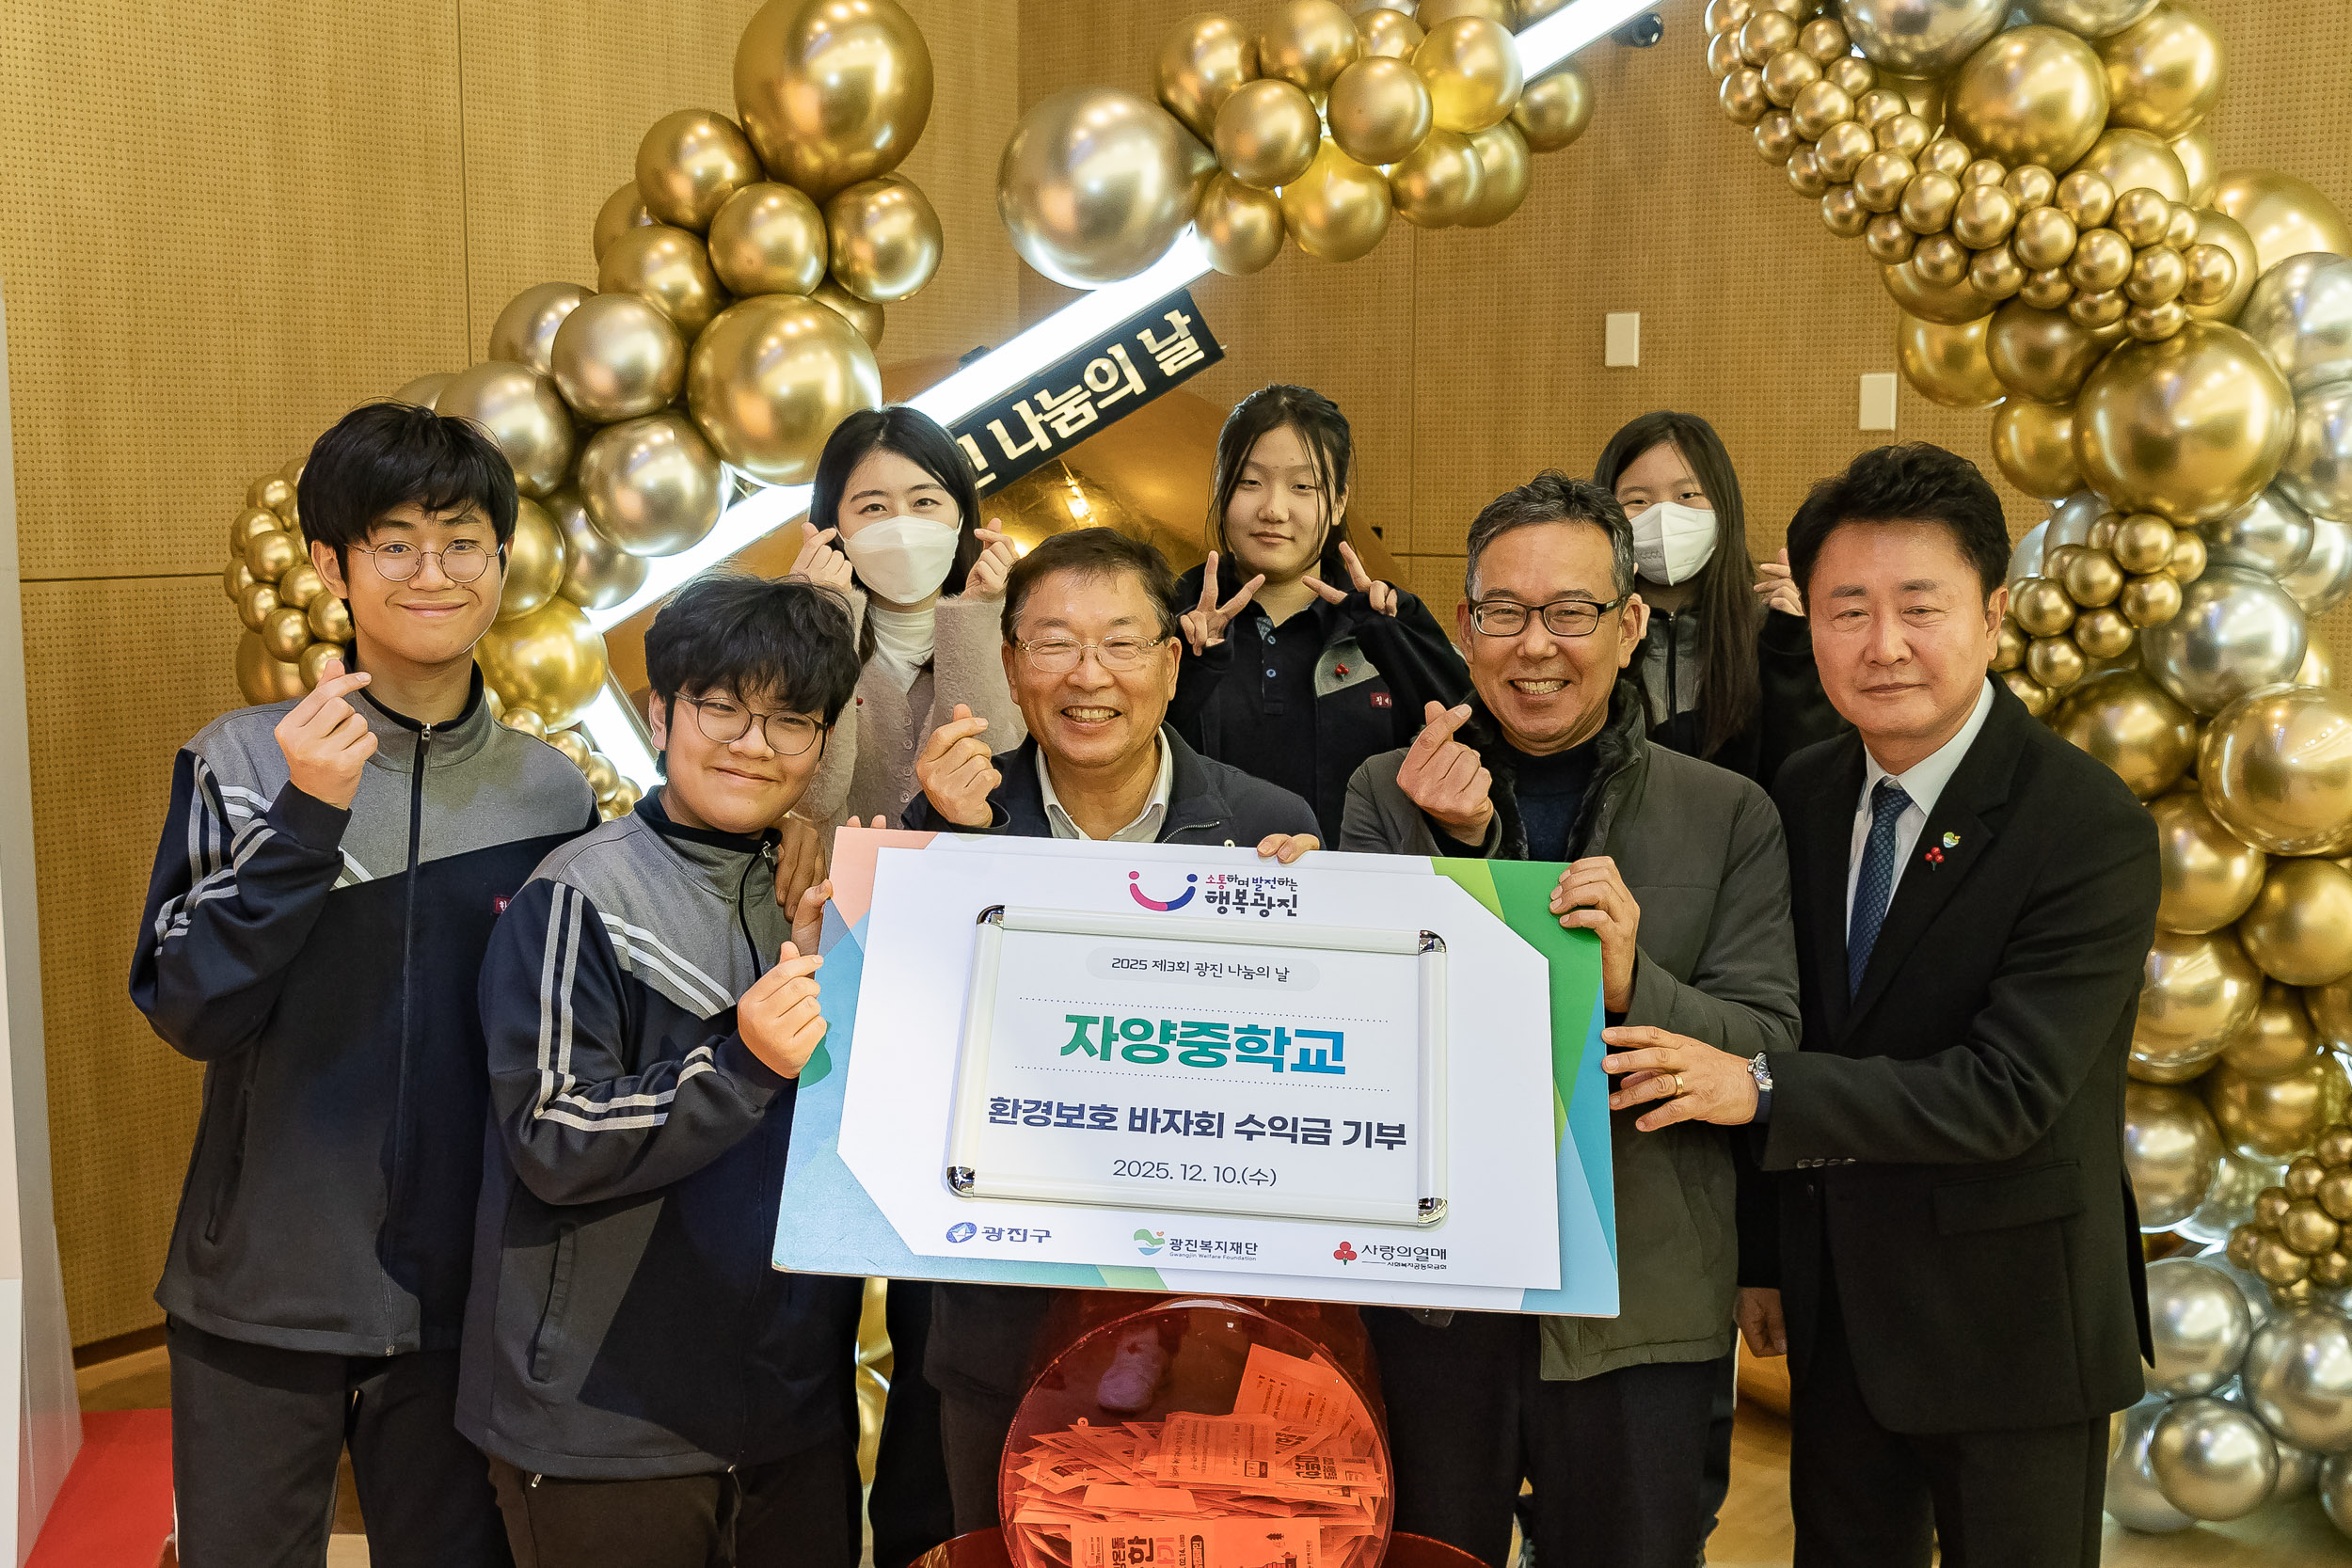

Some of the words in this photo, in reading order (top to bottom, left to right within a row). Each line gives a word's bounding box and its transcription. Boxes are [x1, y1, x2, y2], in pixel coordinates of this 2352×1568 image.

[986, 342, 1147, 461] 나눔의
[1136, 309, 1205, 377] 날
[1205, 874, 1249, 890] 소통하며
[1251, 876, 1299, 893] 발전하는
[1204, 888, 1298, 918] 행복광진
[1111, 958, 1149, 971] 2025
[1151, 958, 1190, 974] 제3회
[1193, 961, 1223, 979] 광진
[1228, 963, 1270, 981] 나눔의
[1275, 966, 1291, 983] 날
[1059, 1014, 1346, 1075] 자양중학교
[988, 1096, 1120, 1132] 환경보호
[1127, 1106, 1225, 1139] 바자회
[1233, 1113, 1333, 1147] 수익금
[1342, 1120, 1407, 1151] 기부
[1112, 1159, 1174, 1180] 2025.
[1180, 1163, 1207, 1182] 12.
[1213, 1165, 1278, 1187] 10.(수)
[980, 1226, 1053, 1243] 광진구
[1168, 1238, 1259, 1256] 광진복지재단
[1169, 1251, 1198, 1259] Gwangjin
[1360, 1244, 1448, 1262] 사랑의열매
